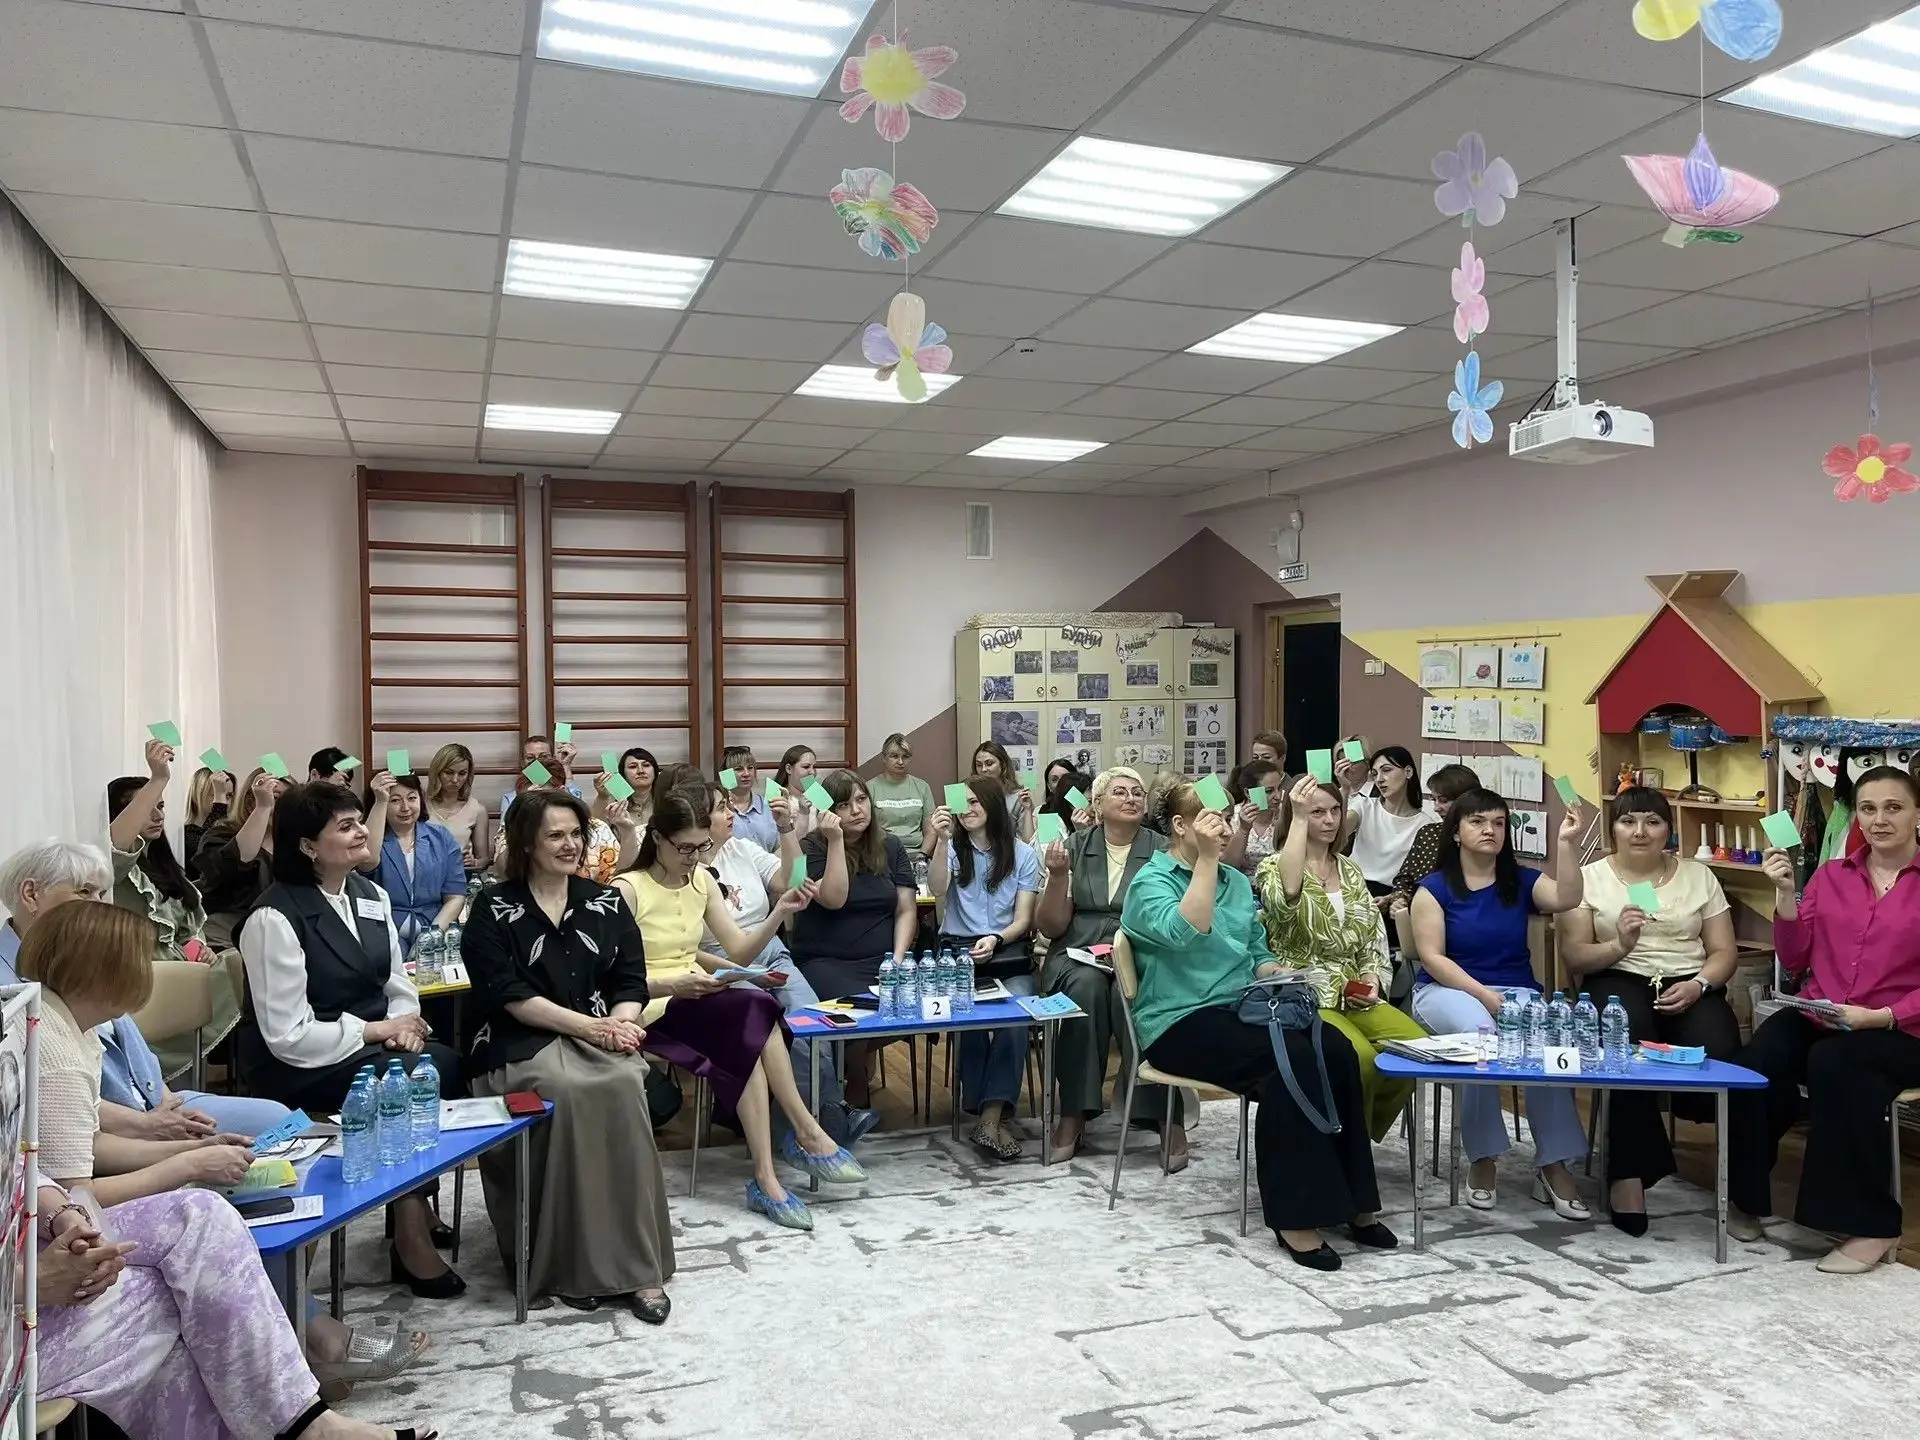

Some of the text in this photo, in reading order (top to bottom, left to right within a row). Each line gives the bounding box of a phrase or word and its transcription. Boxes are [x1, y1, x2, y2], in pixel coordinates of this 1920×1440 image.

[983, 628, 1103, 651] НАШИ БУДНИ
[453, 967, 460, 980] 1
[932, 1001, 941, 1016] 2
[1556, 1051, 1569, 1070] 6
